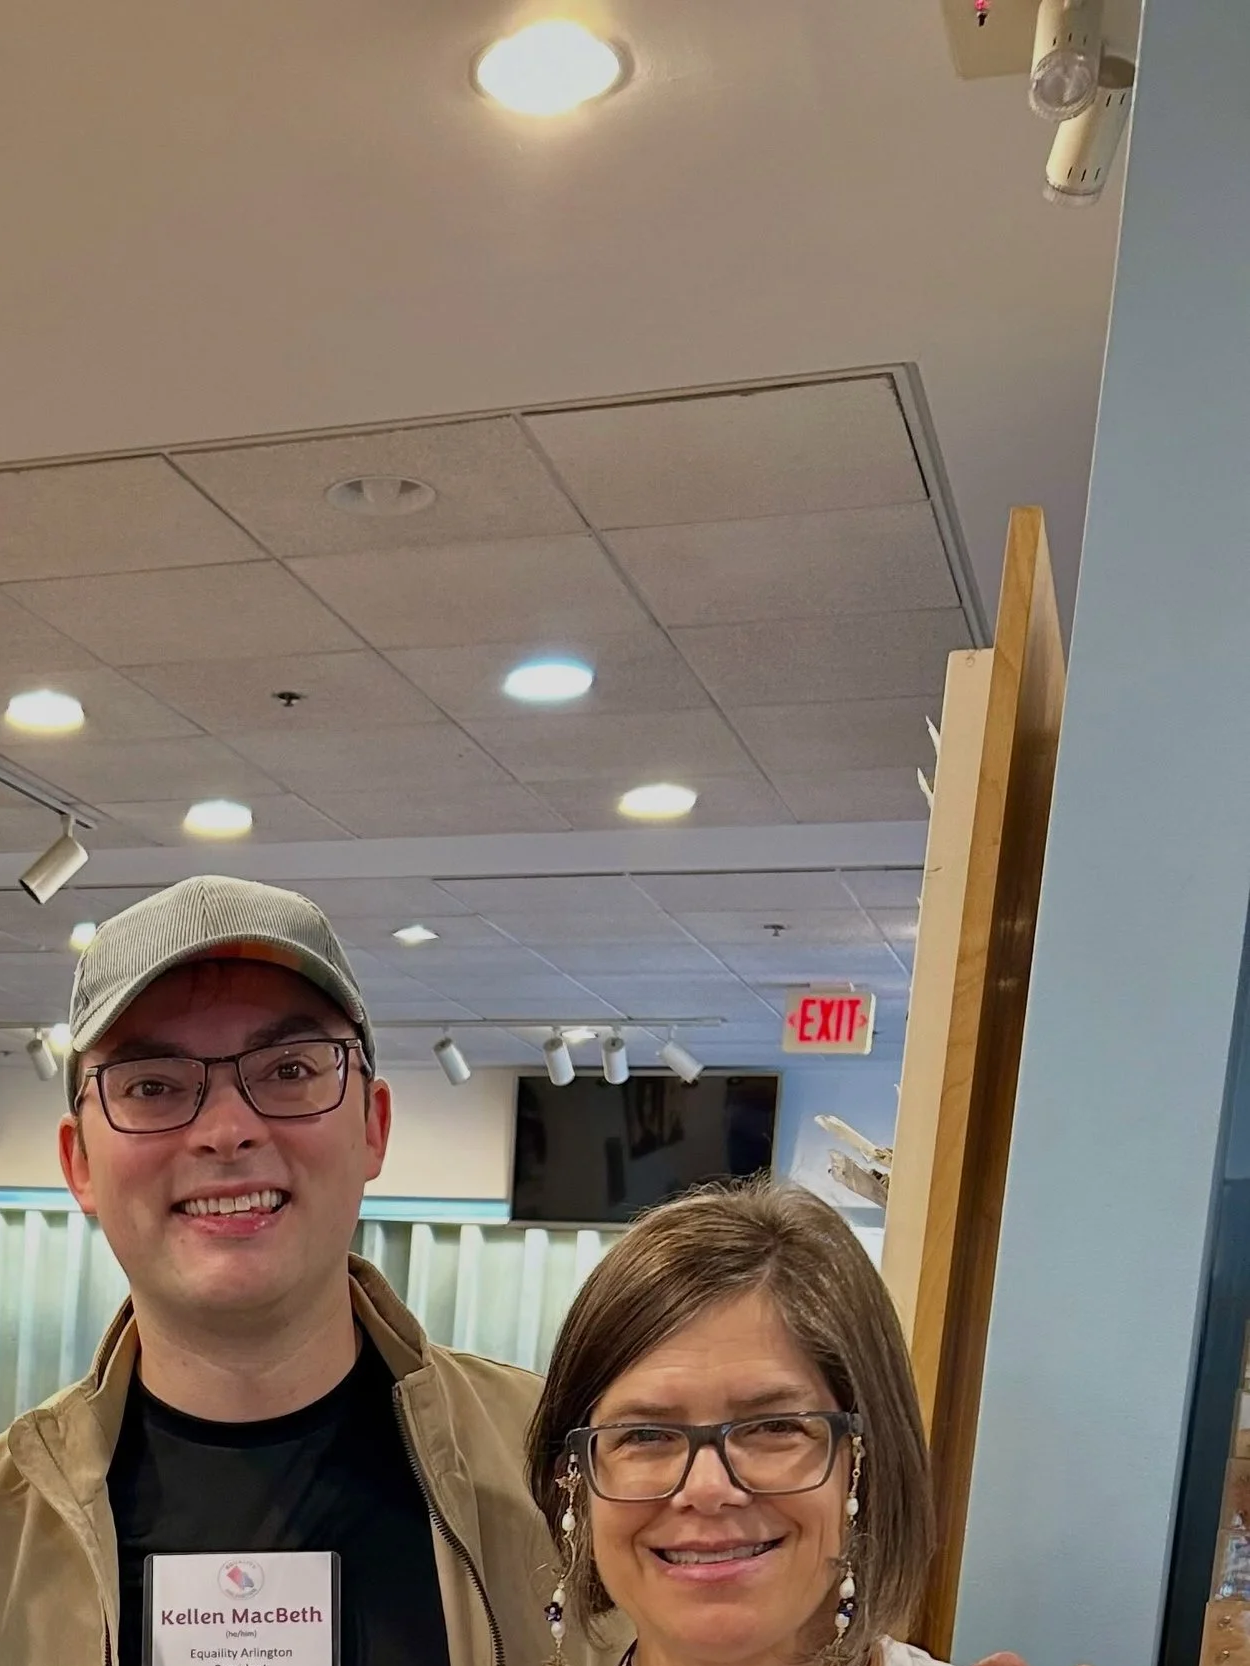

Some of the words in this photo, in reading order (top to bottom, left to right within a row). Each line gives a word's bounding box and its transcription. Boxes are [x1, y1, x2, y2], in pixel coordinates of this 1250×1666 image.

[798, 999, 861, 1042] EXIT
[161, 1608, 225, 1626] Kellen
[232, 1606, 323, 1625] MacBeth
[241, 1647, 293, 1659] Arlington
